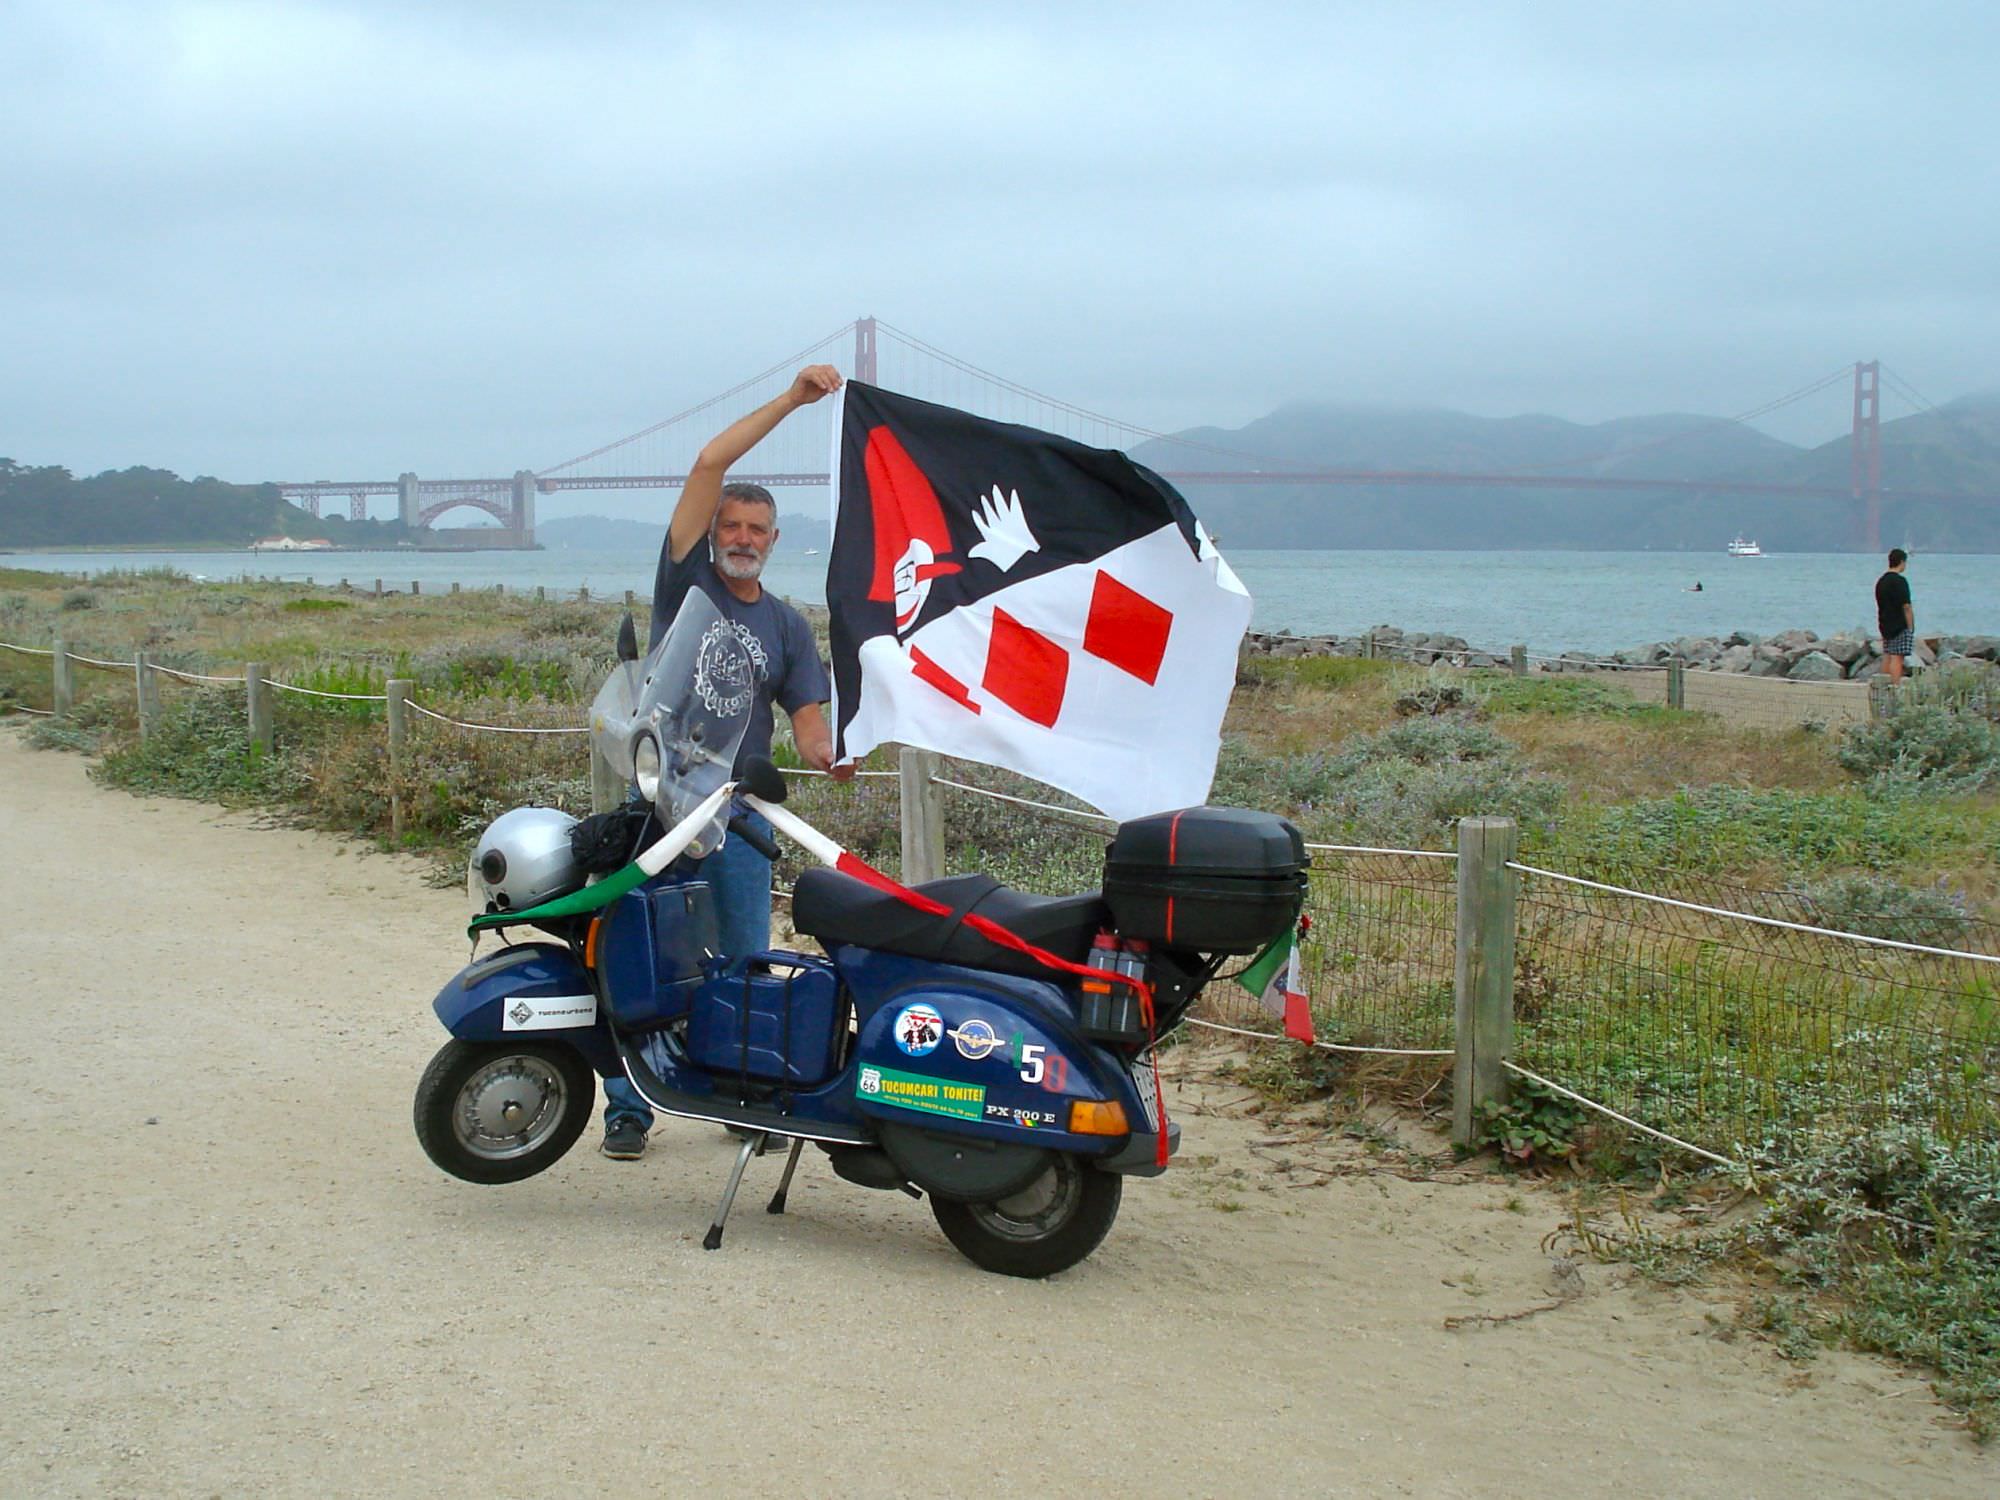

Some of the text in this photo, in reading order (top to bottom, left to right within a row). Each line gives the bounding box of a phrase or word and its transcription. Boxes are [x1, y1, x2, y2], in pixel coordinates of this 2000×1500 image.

[862, 1080, 876, 1092] 66
[880, 1080, 983, 1102] TUCUMCARI TONITE!
[985, 1105, 1056, 1123] PX 200 E
